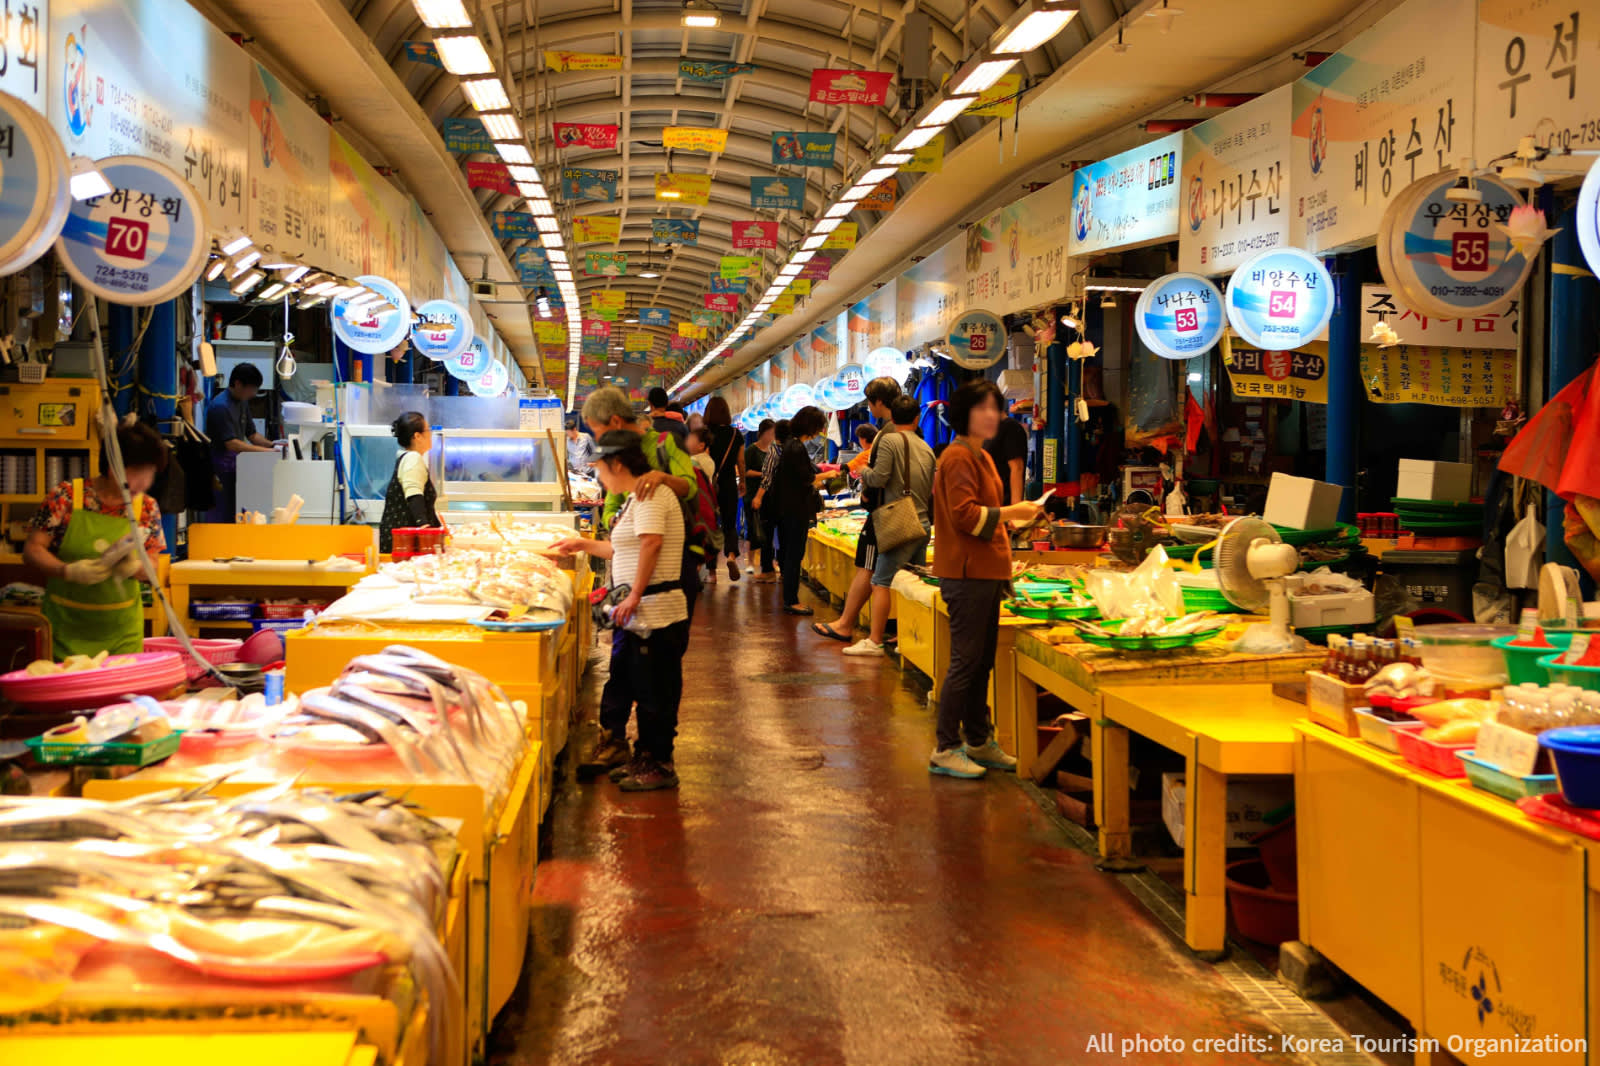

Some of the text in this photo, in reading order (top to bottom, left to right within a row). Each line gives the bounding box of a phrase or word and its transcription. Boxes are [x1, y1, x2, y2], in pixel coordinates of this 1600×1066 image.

[1355, 98, 1454, 206] 비양수산
[1212, 161, 1283, 229] 나나수산
[111, 223, 144, 253] 70
[1456, 240, 1486, 265] 55
[1252, 268, 1319, 290] 비양수산
[1157, 288, 1210, 308] 나나수산
[1271, 295, 1295, 313] 54
[1177, 311, 1196, 328] 53
[971, 337, 985, 348] 26
